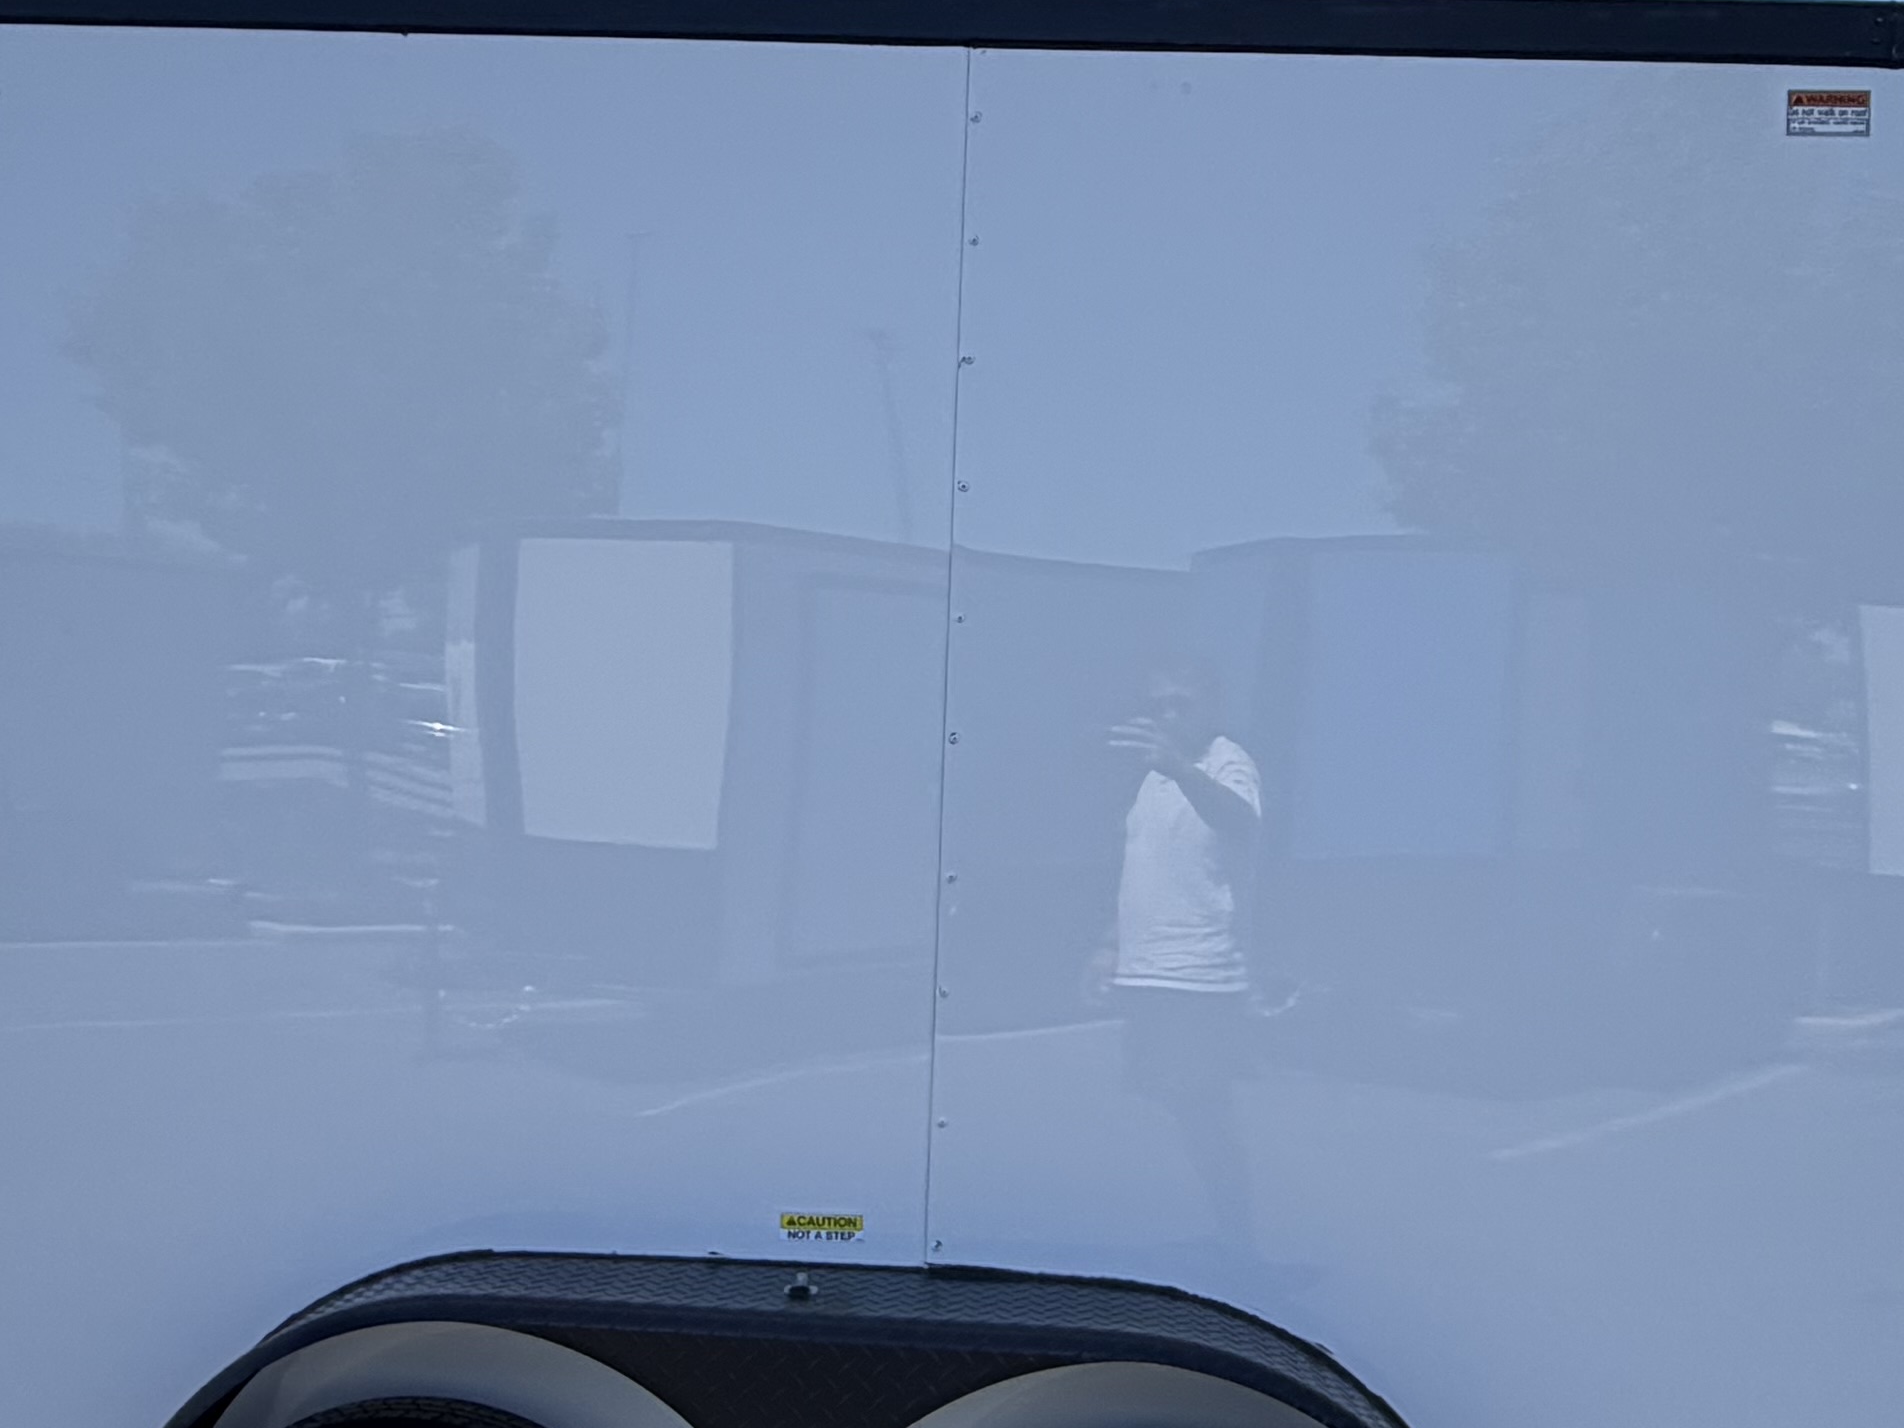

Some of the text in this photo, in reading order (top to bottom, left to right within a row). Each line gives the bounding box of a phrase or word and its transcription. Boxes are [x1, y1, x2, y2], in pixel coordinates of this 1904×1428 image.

[796, 1216, 857, 1228] CAUTION
[787, 1230, 855, 1241] NOT A STEP
